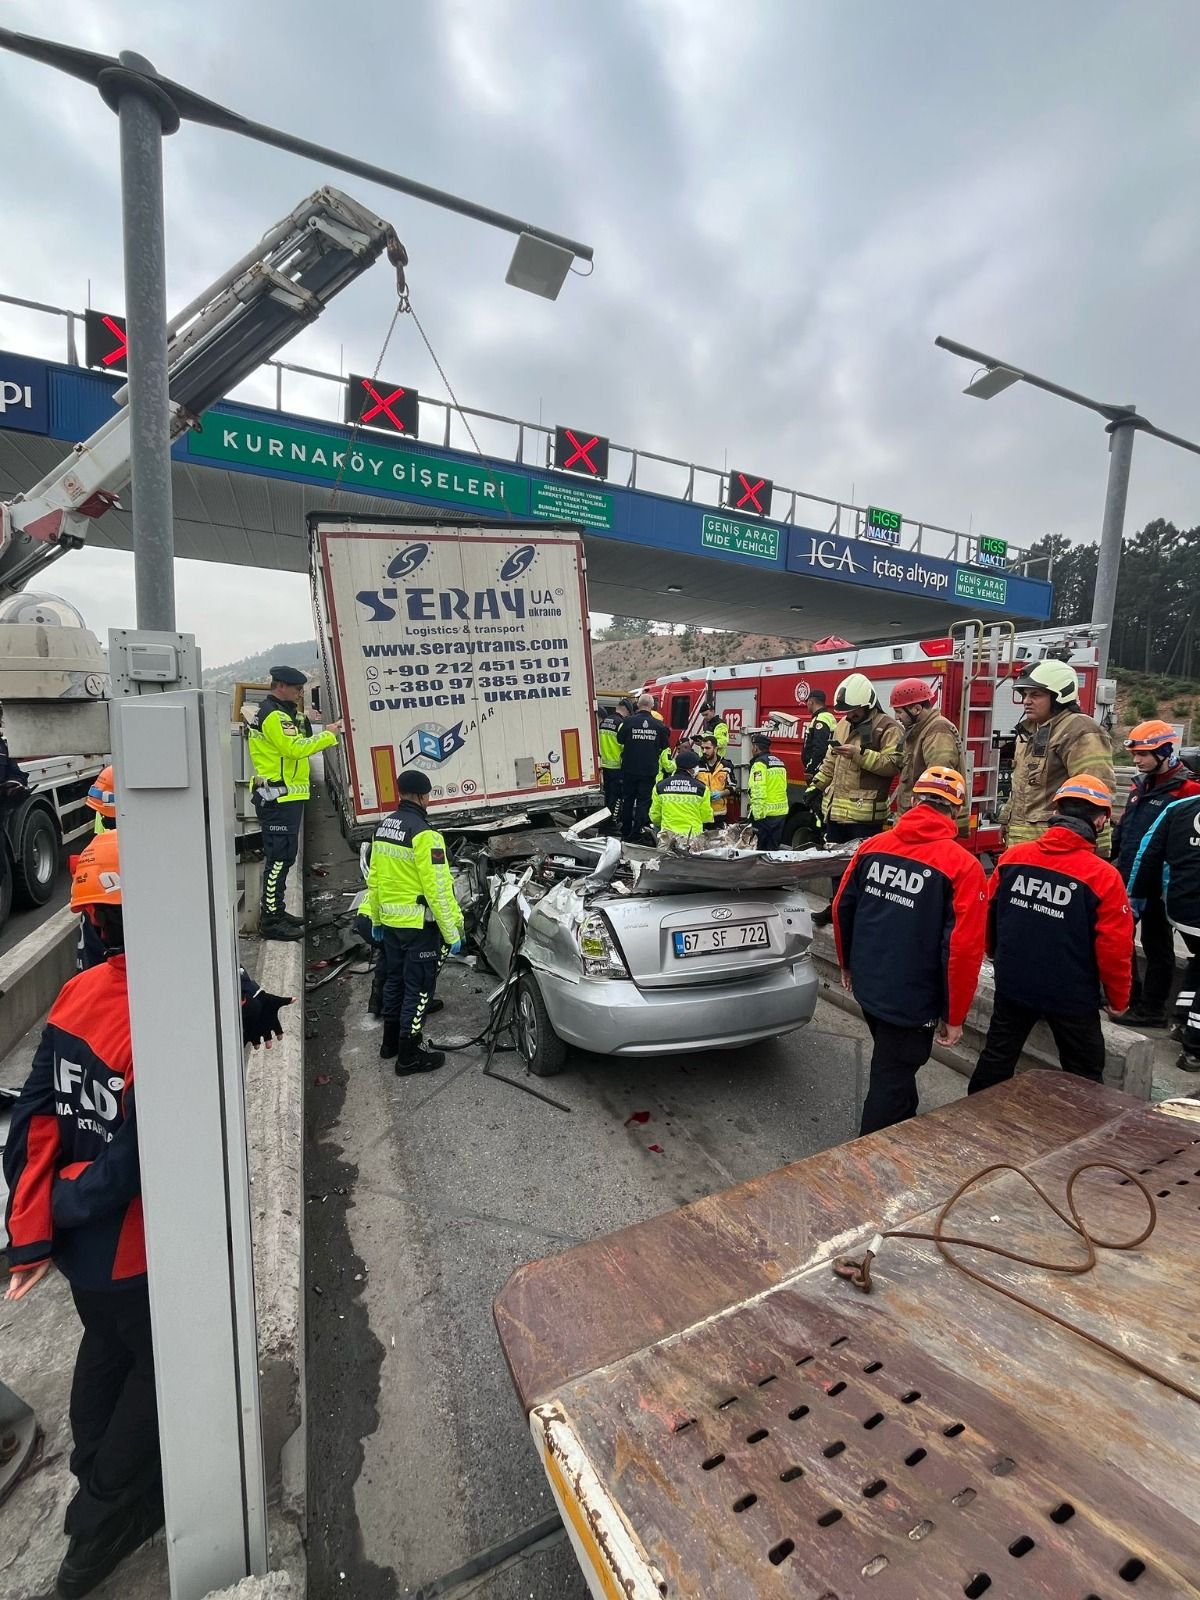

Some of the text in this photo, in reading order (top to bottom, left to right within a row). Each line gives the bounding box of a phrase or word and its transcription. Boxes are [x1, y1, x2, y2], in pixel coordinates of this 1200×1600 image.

[223, 429, 505, 499] KURNAKÖY GİŞELERİ
[872, 511, 899, 529] HGS
[707, 520, 775, 545] GENİŞ ARAÇ
[868, 526, 899, 543] NAKİT
[705, 532, 776, 556] WIDE VEHICLE
[983, 538, 1005, 554] HGS
[810, 537, 949, 591] ICA içtaş altyapı
[979, 551, 1006, 567] NAKİT
[957, 583, 1005, 602] WIDE VEHICLE
[959, 573, 1004, 593] GENİŞ ARAÇ
[355, 587, 525, 622] SERAY
[405, 624, 525, 637] Logistics & transport
[362, 638, 569, 658] www.seraytrans.com
[383, 657, 569, 677] +90 212 451 51 01
[385, 672, 570, 693] +380 97 385 9807
[369, 693, 466, 712] OVRUCH
[463, 707, 495, 735] JAAR
[725, 713, 741, 731] 112
[405, 733, 455, 755] 125
[463, 783, 474, 792] 90
[866, 861, 925, 895] AFAD
[1010, 874, 1073, 907] AFAD
[684, 926, 765, 951] 67 SF 722
